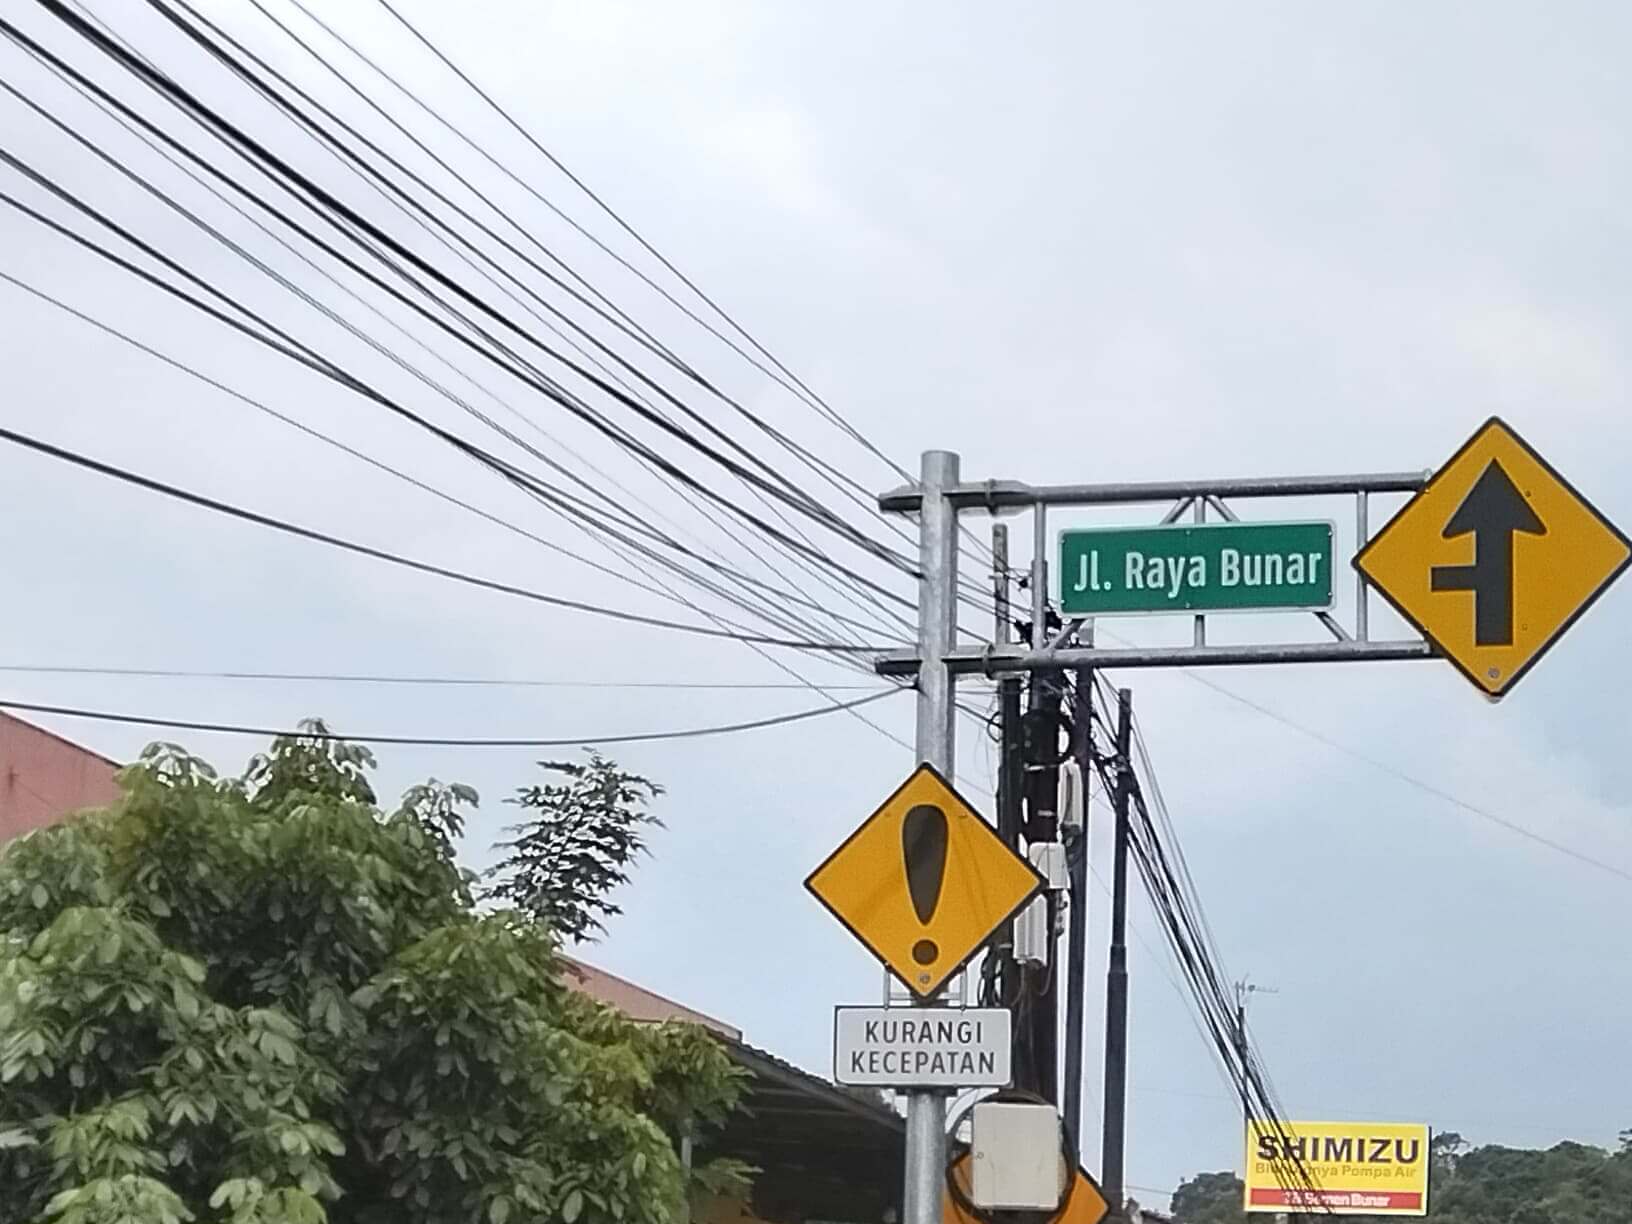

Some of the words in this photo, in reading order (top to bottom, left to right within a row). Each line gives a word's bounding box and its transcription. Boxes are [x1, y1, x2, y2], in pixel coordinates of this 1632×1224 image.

[1073, 550, 1112, 591] Jl.
[1125, 551, 1207, 598] Raya
[1221, 548, 1322, 587] Bunar
[865, 1020, 982, 1044] KURANGI
[851, 1050, 995, 1074] KECEPATAN
[1257, 1135, 1419, 1164] SHIMIZU
[1342, 1164, 1391, 1179] Pompa
[1395, 1166, 1416, 1177] Air
